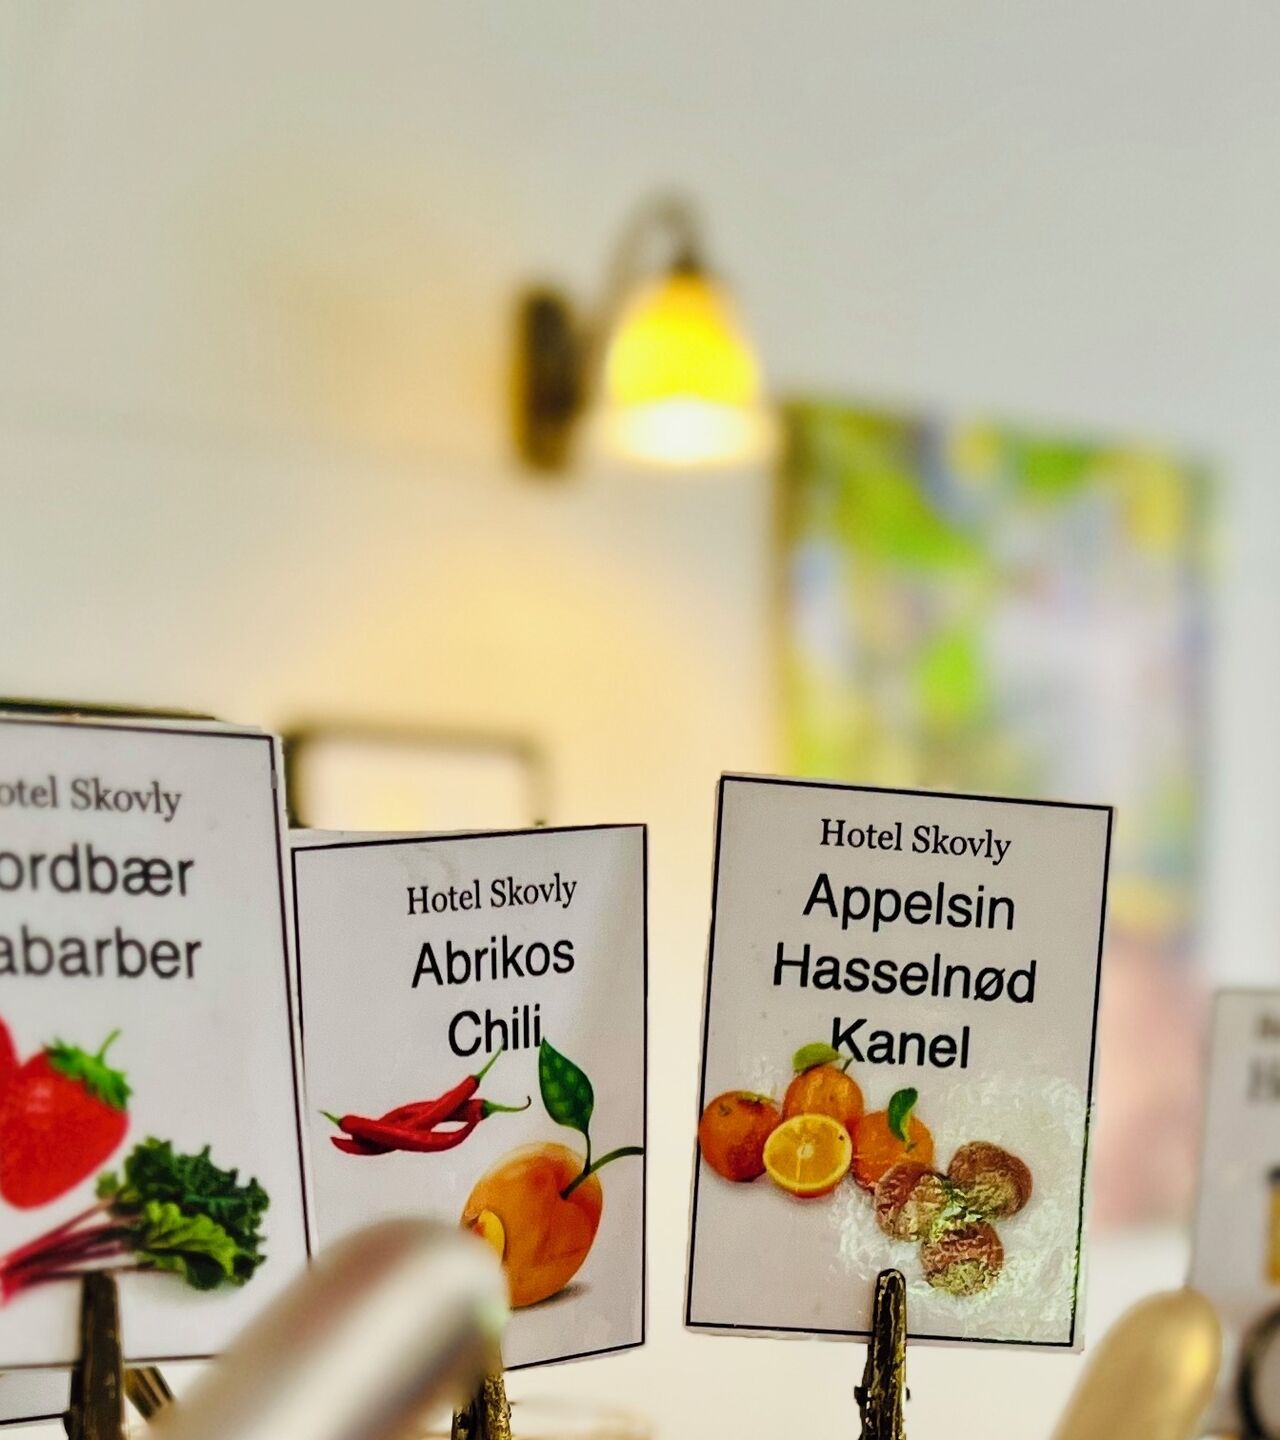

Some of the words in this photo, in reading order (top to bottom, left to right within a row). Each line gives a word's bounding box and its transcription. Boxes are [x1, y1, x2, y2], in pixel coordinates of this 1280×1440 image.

[70, 776, 183, 822] Skovly
[819, 818, 903, 852] Hotel
[910, 823, 1013, 866] Skovly
[406, 879, 482, 915] Hotel
[489, 872, 578, 910] Skovly
[801, 872, 1016, 933] Appelsin
[411, 934, 576, 989] Abrikos
[772, 941, 1038, 1004] Hasselnød
[447, 1003, 542, 1058] Chili
[830, 1016, 971, 1070] Kanel
